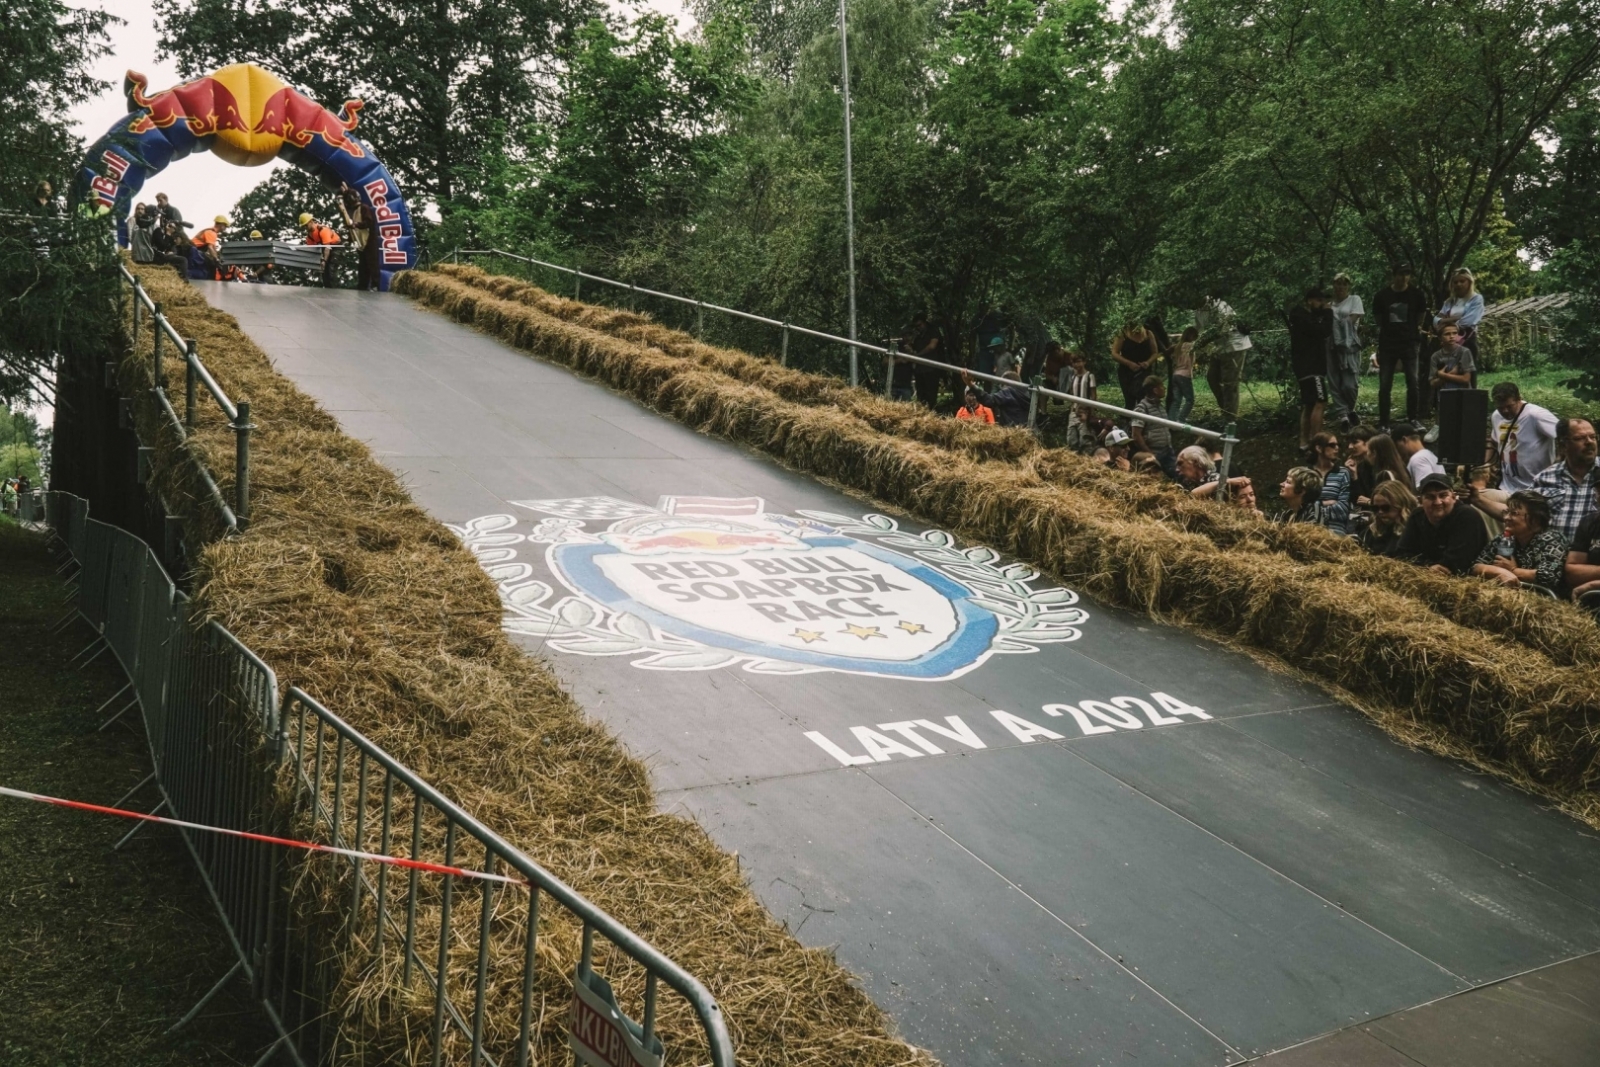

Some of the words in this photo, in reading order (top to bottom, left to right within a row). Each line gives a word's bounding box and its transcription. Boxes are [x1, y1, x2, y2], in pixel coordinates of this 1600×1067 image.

[91, 149, 130, 198] Bull
[363, 178, 400, 223] Red
[379, 224, 407, 264] Bull
[631, 560, 740, 581] RED
[742, 555, 870, 576] BULL
[657, 573, 911, 603] SOAPBOX
[747, 596, 899, 623] RACE
[1041, 692, 1213, 736] 2024
